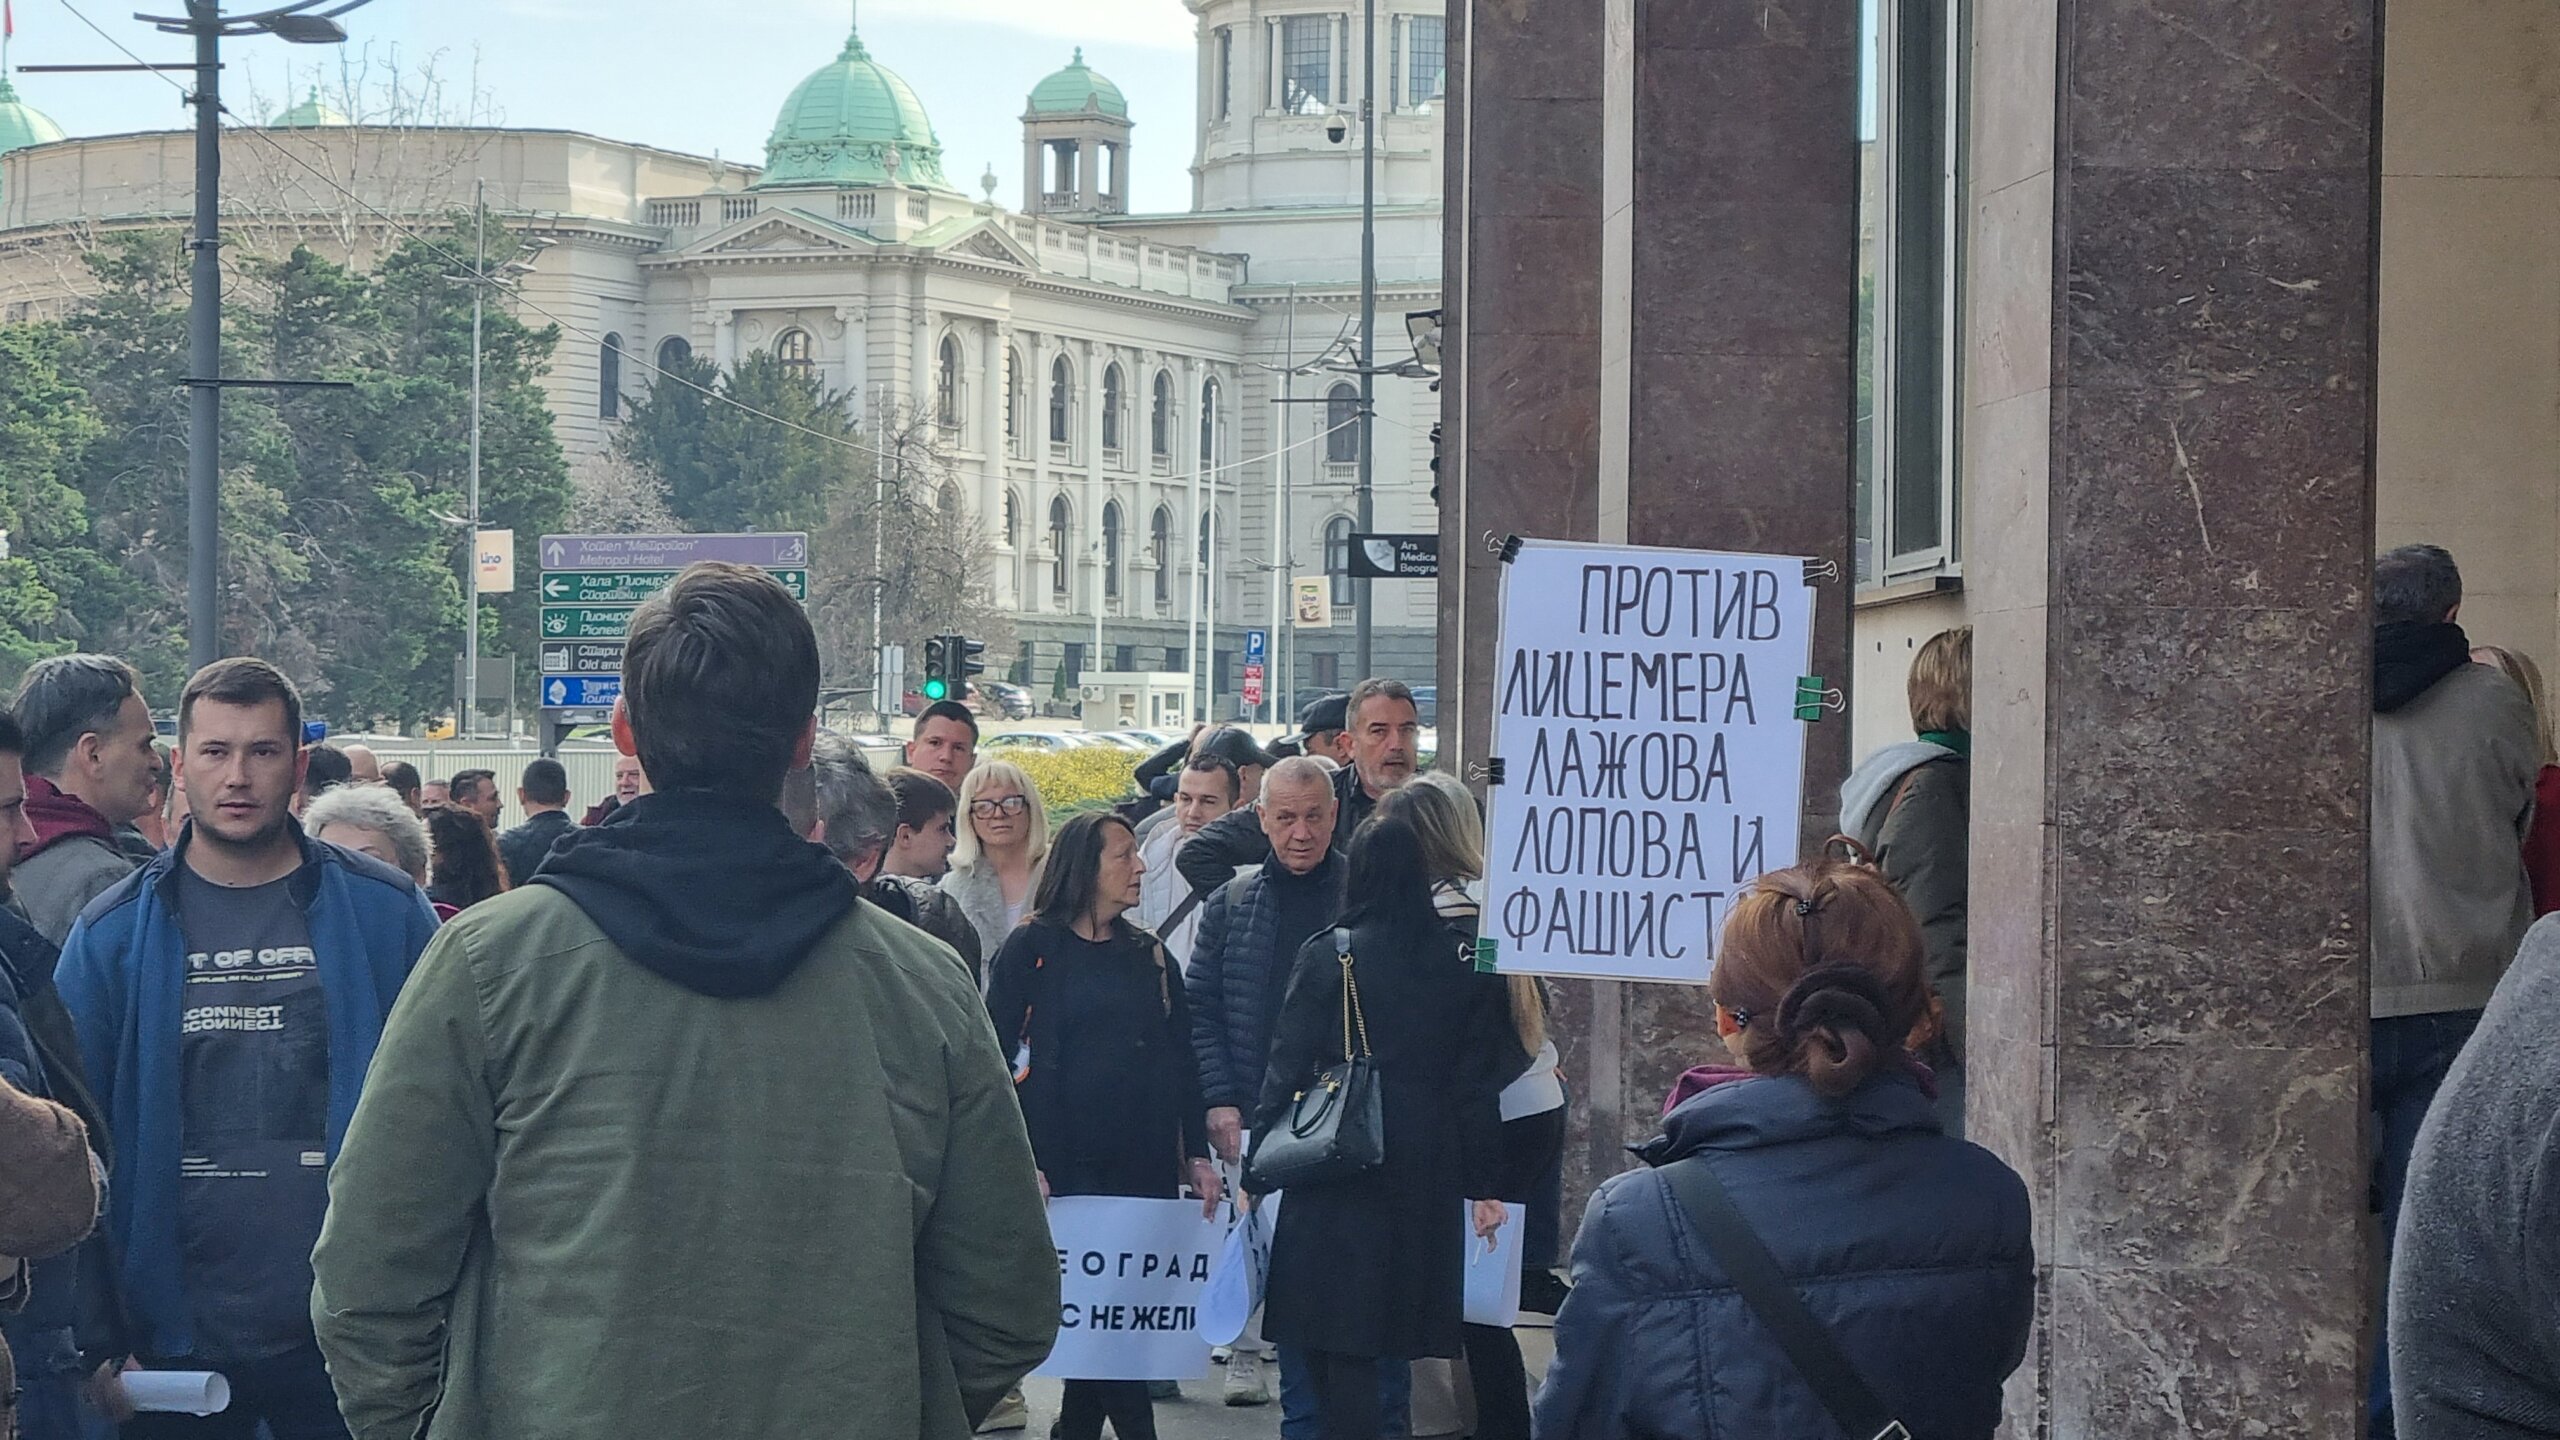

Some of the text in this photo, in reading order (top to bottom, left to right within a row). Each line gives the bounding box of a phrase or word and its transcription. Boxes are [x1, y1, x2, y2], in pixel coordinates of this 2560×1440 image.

[1400, 541, 1418, 551] Ars
[580, 553, 664, 567] Metropol Hotel
[1400, 552, 1437, 562] Medica
[580, 575, 612, 587] Хала
[1578, 564, 1781, 642] ПРОТИВ
[1250, 633, 1261, 654] P
[578, 659, 599, 671] Old
[1501, 647, 1757, 726] ЛИЦЕМЕРА
[1524, 726, 1732, 805] ЛАЖОВА
[1512, 805, 1764, 885] ЛОПОВА И
[1502, 885, 1747, 961] ФАШИСТ
[213, 949, 254, 970] OF
[1090, 1305, 1125, 1330] НЕ
